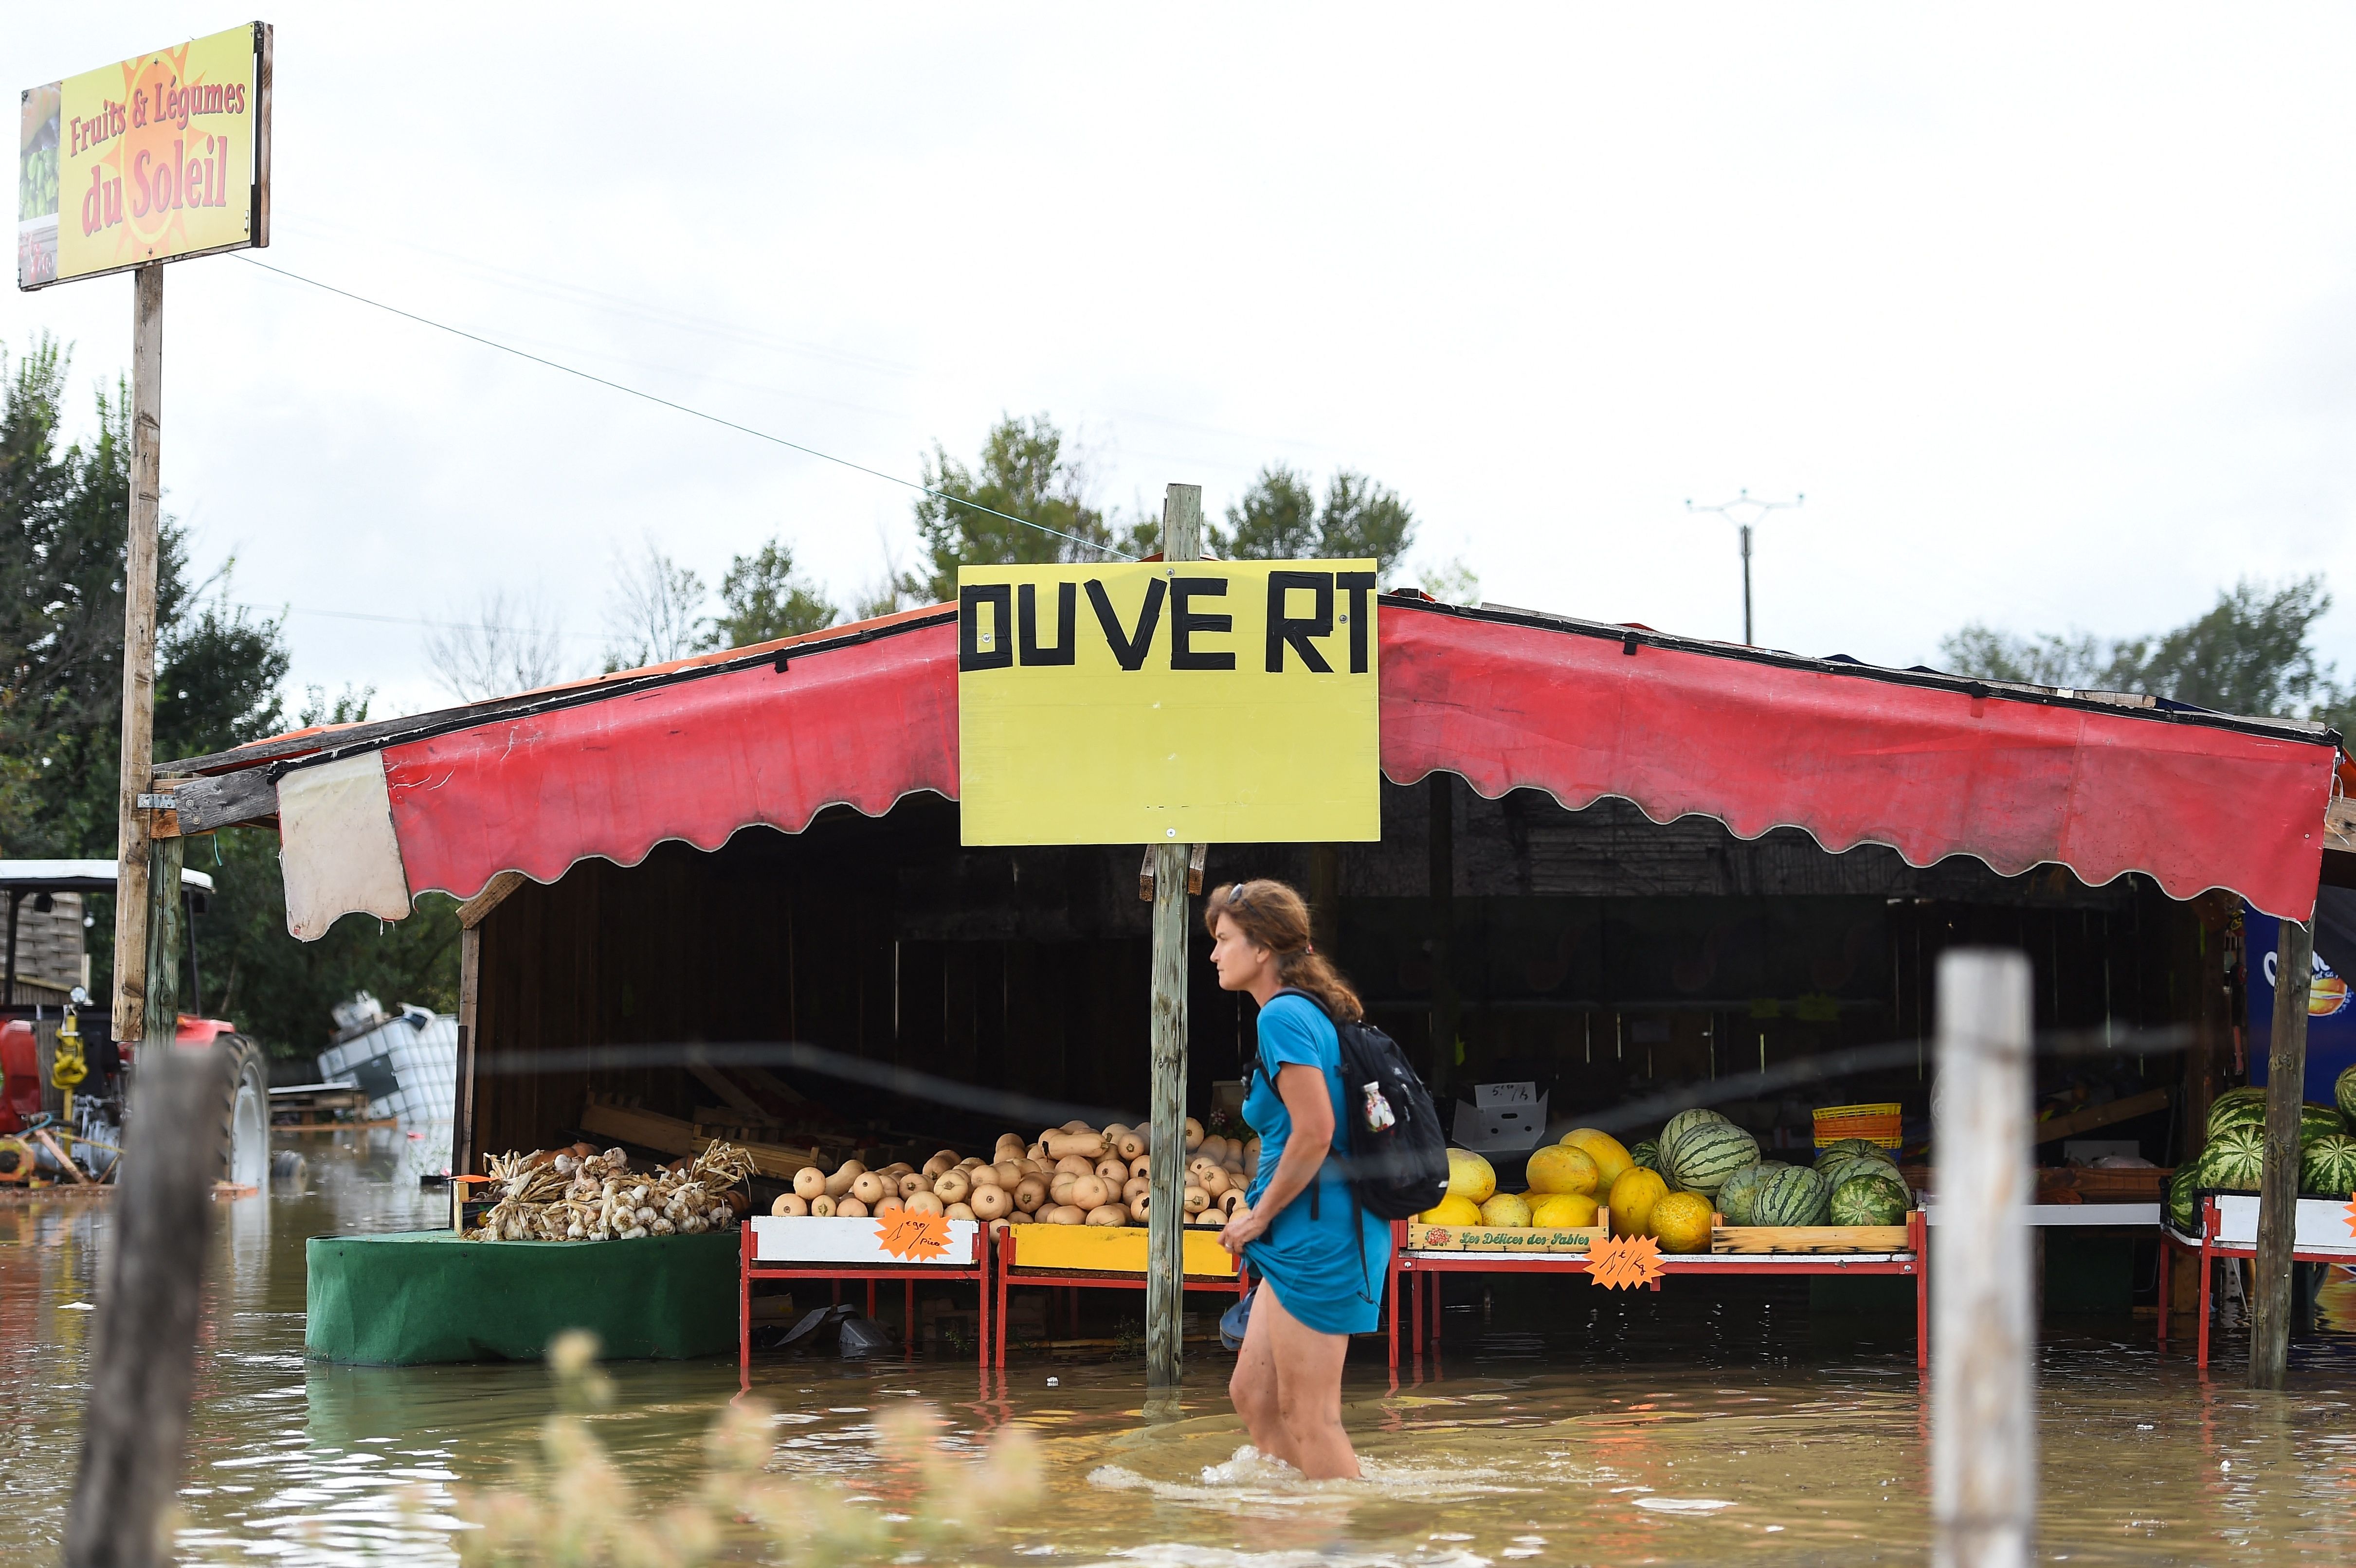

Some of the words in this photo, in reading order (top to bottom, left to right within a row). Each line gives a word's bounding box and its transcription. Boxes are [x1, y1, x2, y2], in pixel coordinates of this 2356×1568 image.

[70, 99, 126, 158] Fruits
[132, 88, 148, 128] &
[154, 74, 245, 130] Légumes
[82, 164, 123, 237] du
[133, 134, 228, 218] Soleil
[1459, 1232, 1480, 1244] Les
[1482, 1232, 1523, 1244] Délices
[1527, 1233, 1547, 1245] des
[1550, 1232, 1590, 1245] Sables
